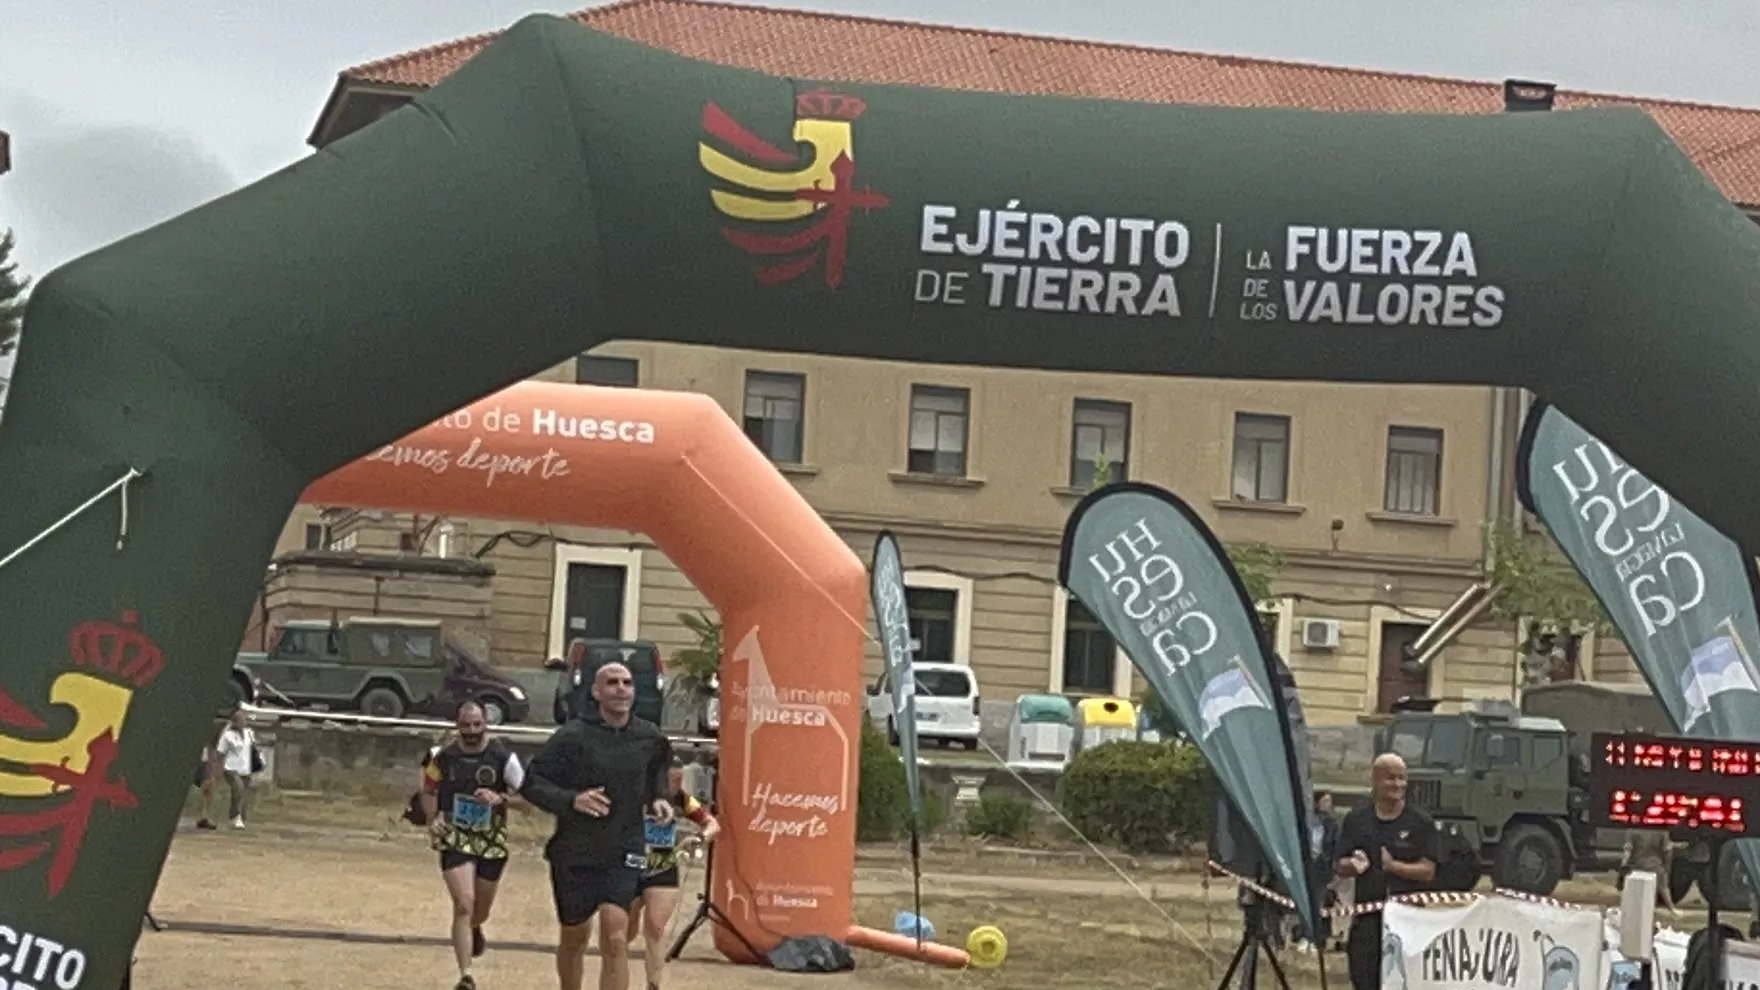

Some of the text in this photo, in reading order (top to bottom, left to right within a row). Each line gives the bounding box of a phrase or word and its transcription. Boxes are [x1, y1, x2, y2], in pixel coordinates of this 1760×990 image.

[920, 200, 1190, 268] EJÉRCITO
[1246, 225, 1478, 277] LA FUERZA
[914, 263, 1181, 316] DE TIERRA
[1240, 279, 1505, 327] LOS VALORES
[1243, 278, 1269, 298] DE
[483, 407, 521, 433] de
[533, 408, 655, 443] Huesca
[457, 437, 571, 488] deporte
[752, 708, 826, 727] Huesca
[752, 782, 839, 815] Hacemos
